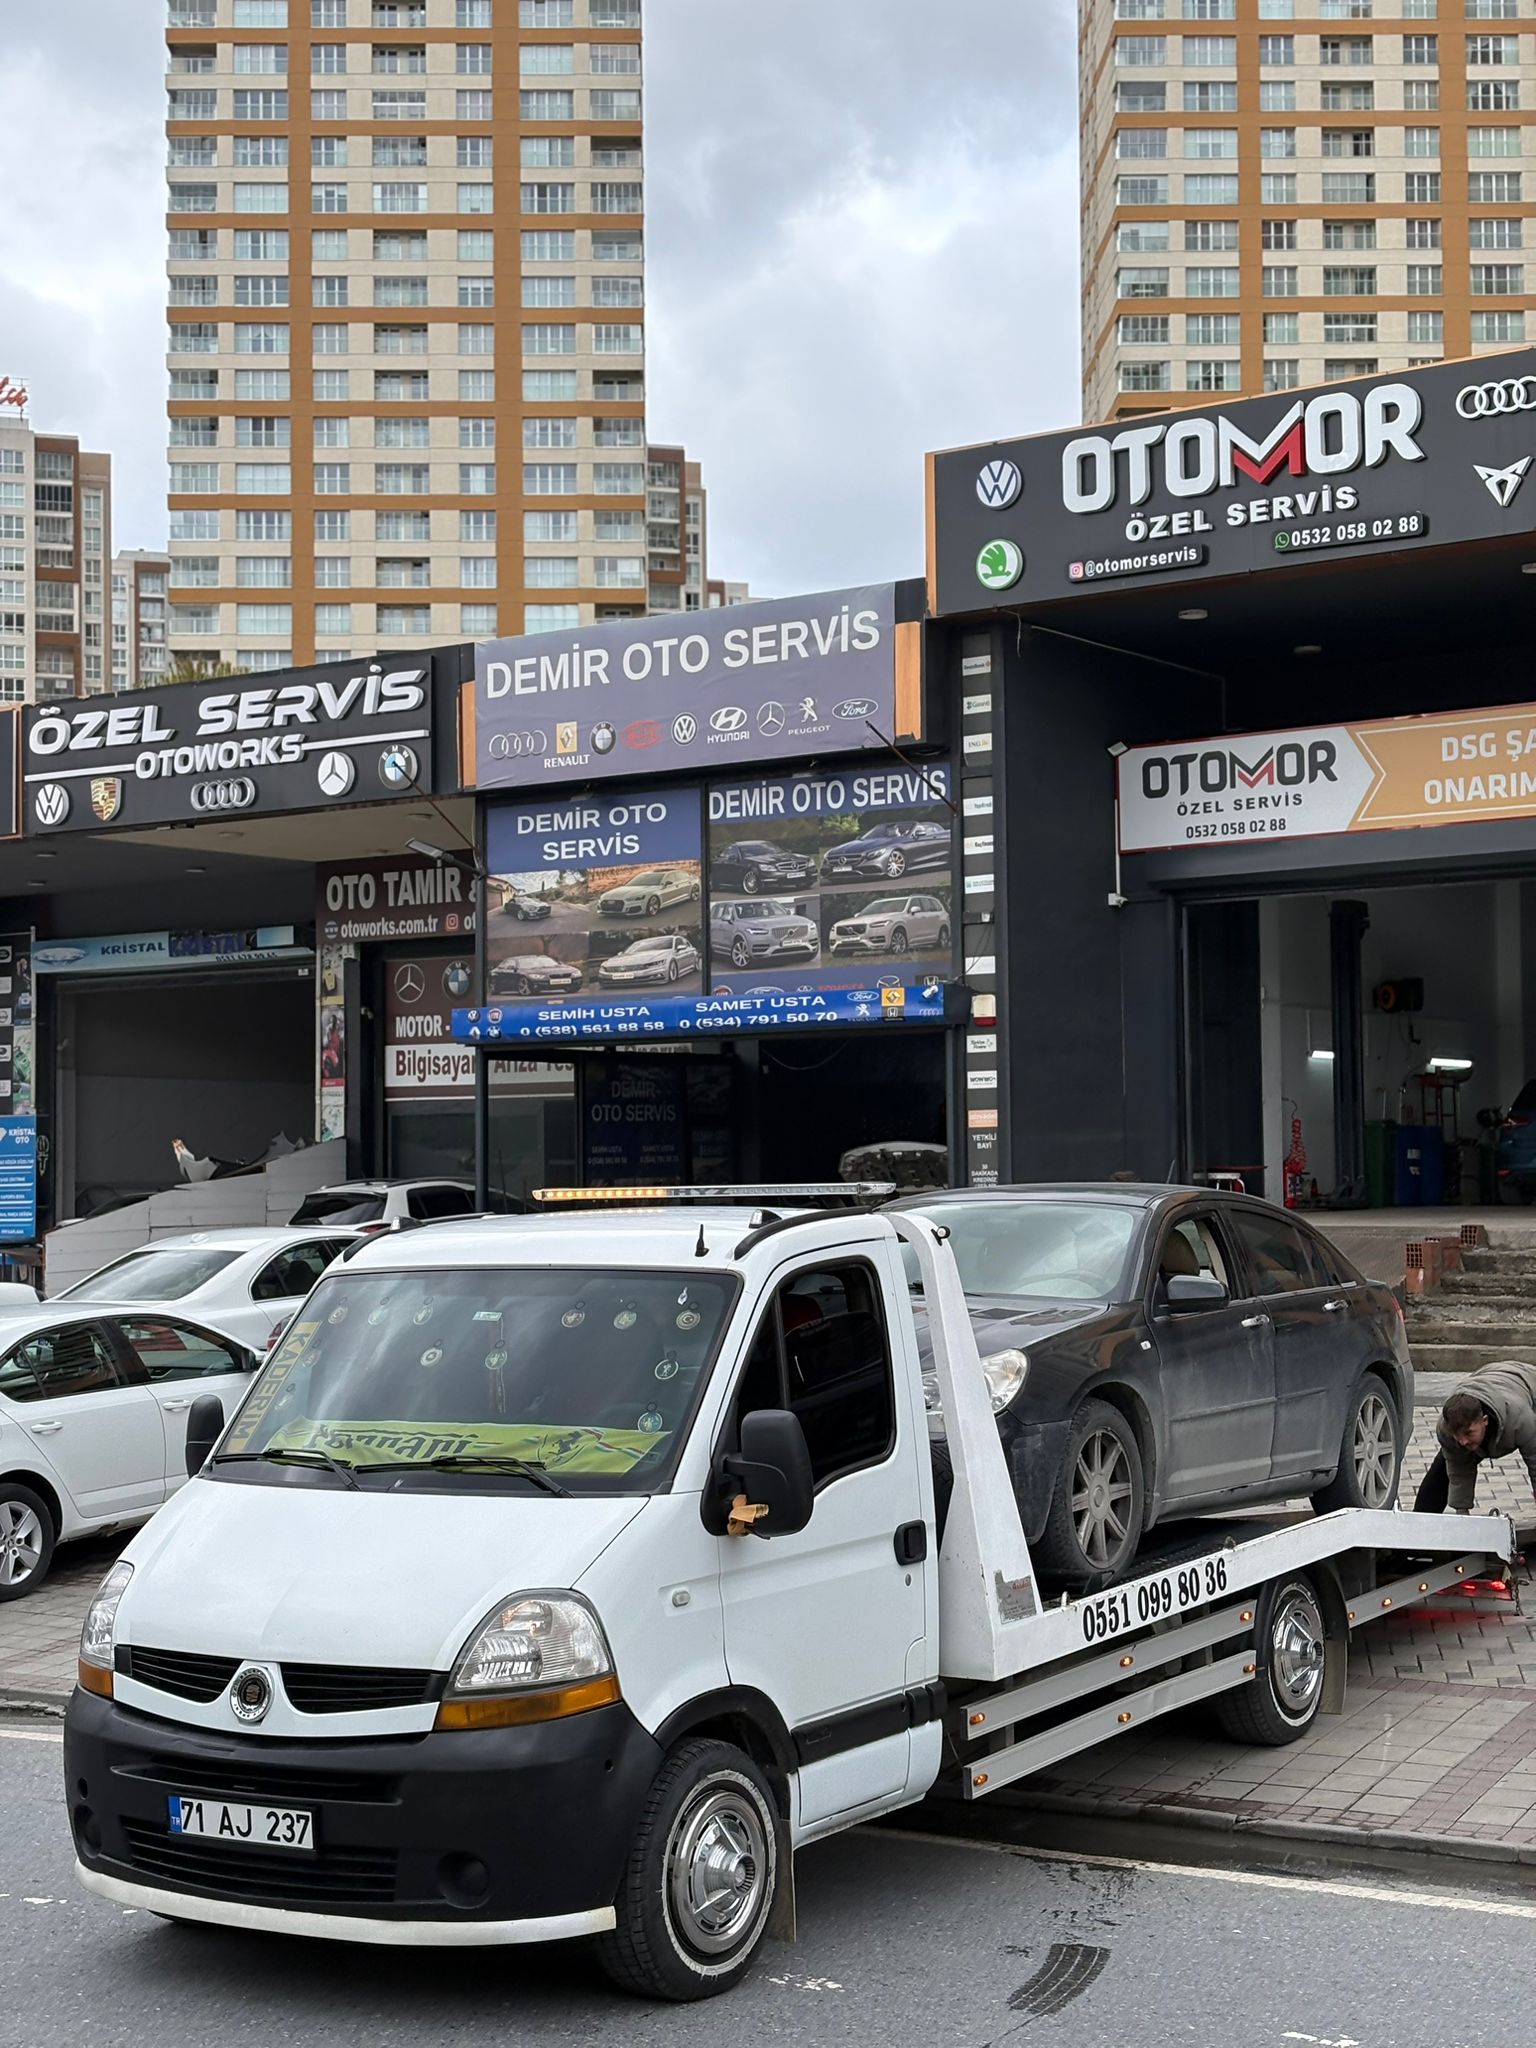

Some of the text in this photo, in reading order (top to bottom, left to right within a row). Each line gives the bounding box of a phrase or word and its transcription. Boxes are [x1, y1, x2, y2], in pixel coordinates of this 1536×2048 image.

[1062, 383, 1428, 513] OTOMOR
[1126, 484, 1359, 542] ÖZEL SERVİS
[1291, 515, 1419, 547] 0532 058 02 88
[1084, 547, 1198, 577] @otomorservis
[487, 606, 880, 699] DEMİR OTO SERVİS
[29, 665, 426, 755] ÖZEL SERVİS
[841, 701, 868, 716] Ford
[707, 731, 750, 744] HYUNDAI
[788, 725, 831, 735] PEUGEOT
[134, 733, 305, 779] OTOWORKS
[1441, 732, 1497, 762] DSG
[544, 754, 590, 769] RENAULT
[1141, 740, 1338, 799] OTOMOR
[709, 766, 946, 821] DEMİR OTO SERVİS
[1424, 771, 1536, 805] ONARIM
[1177, 792, 1303, 816] ÖZEL SERVİS
[517, 803, 668, 835] DEMİR OTO
[1186, 818, 1287, 839] 0532 058 02 88
[542, 832, 640, 862] SERVİS
[326, 873, 376, 911] OTO
[383, 859, 462, 907] TAMİR
[341, 914, 438, 938] otoworks.com.tr
[100, 941, 166, 955] KRİSTAL
[538, 1006, 650, 1021] SEMİH USTA
[696, 995, 826, 1012] SAMET USTA
[396, 1015, 442, 1038] MOTOR
[520, 1021, 665, 1037] 0 (538) 561 88 58
[679, 1011, 838, 1029] 0 (534) 791 50 70
[591, 1100, 676, 1122] OTO SERVİS
[8, 1126, 36, 1137] KRİSTAL
[15, 1136, 30, 1144] OTO
[1083, 1557, 1227, 1642] 0551 099 80 36
[171, 1816, 181, 1825] TR
[181, 1800, 310, 1845] 71 AJ 237
